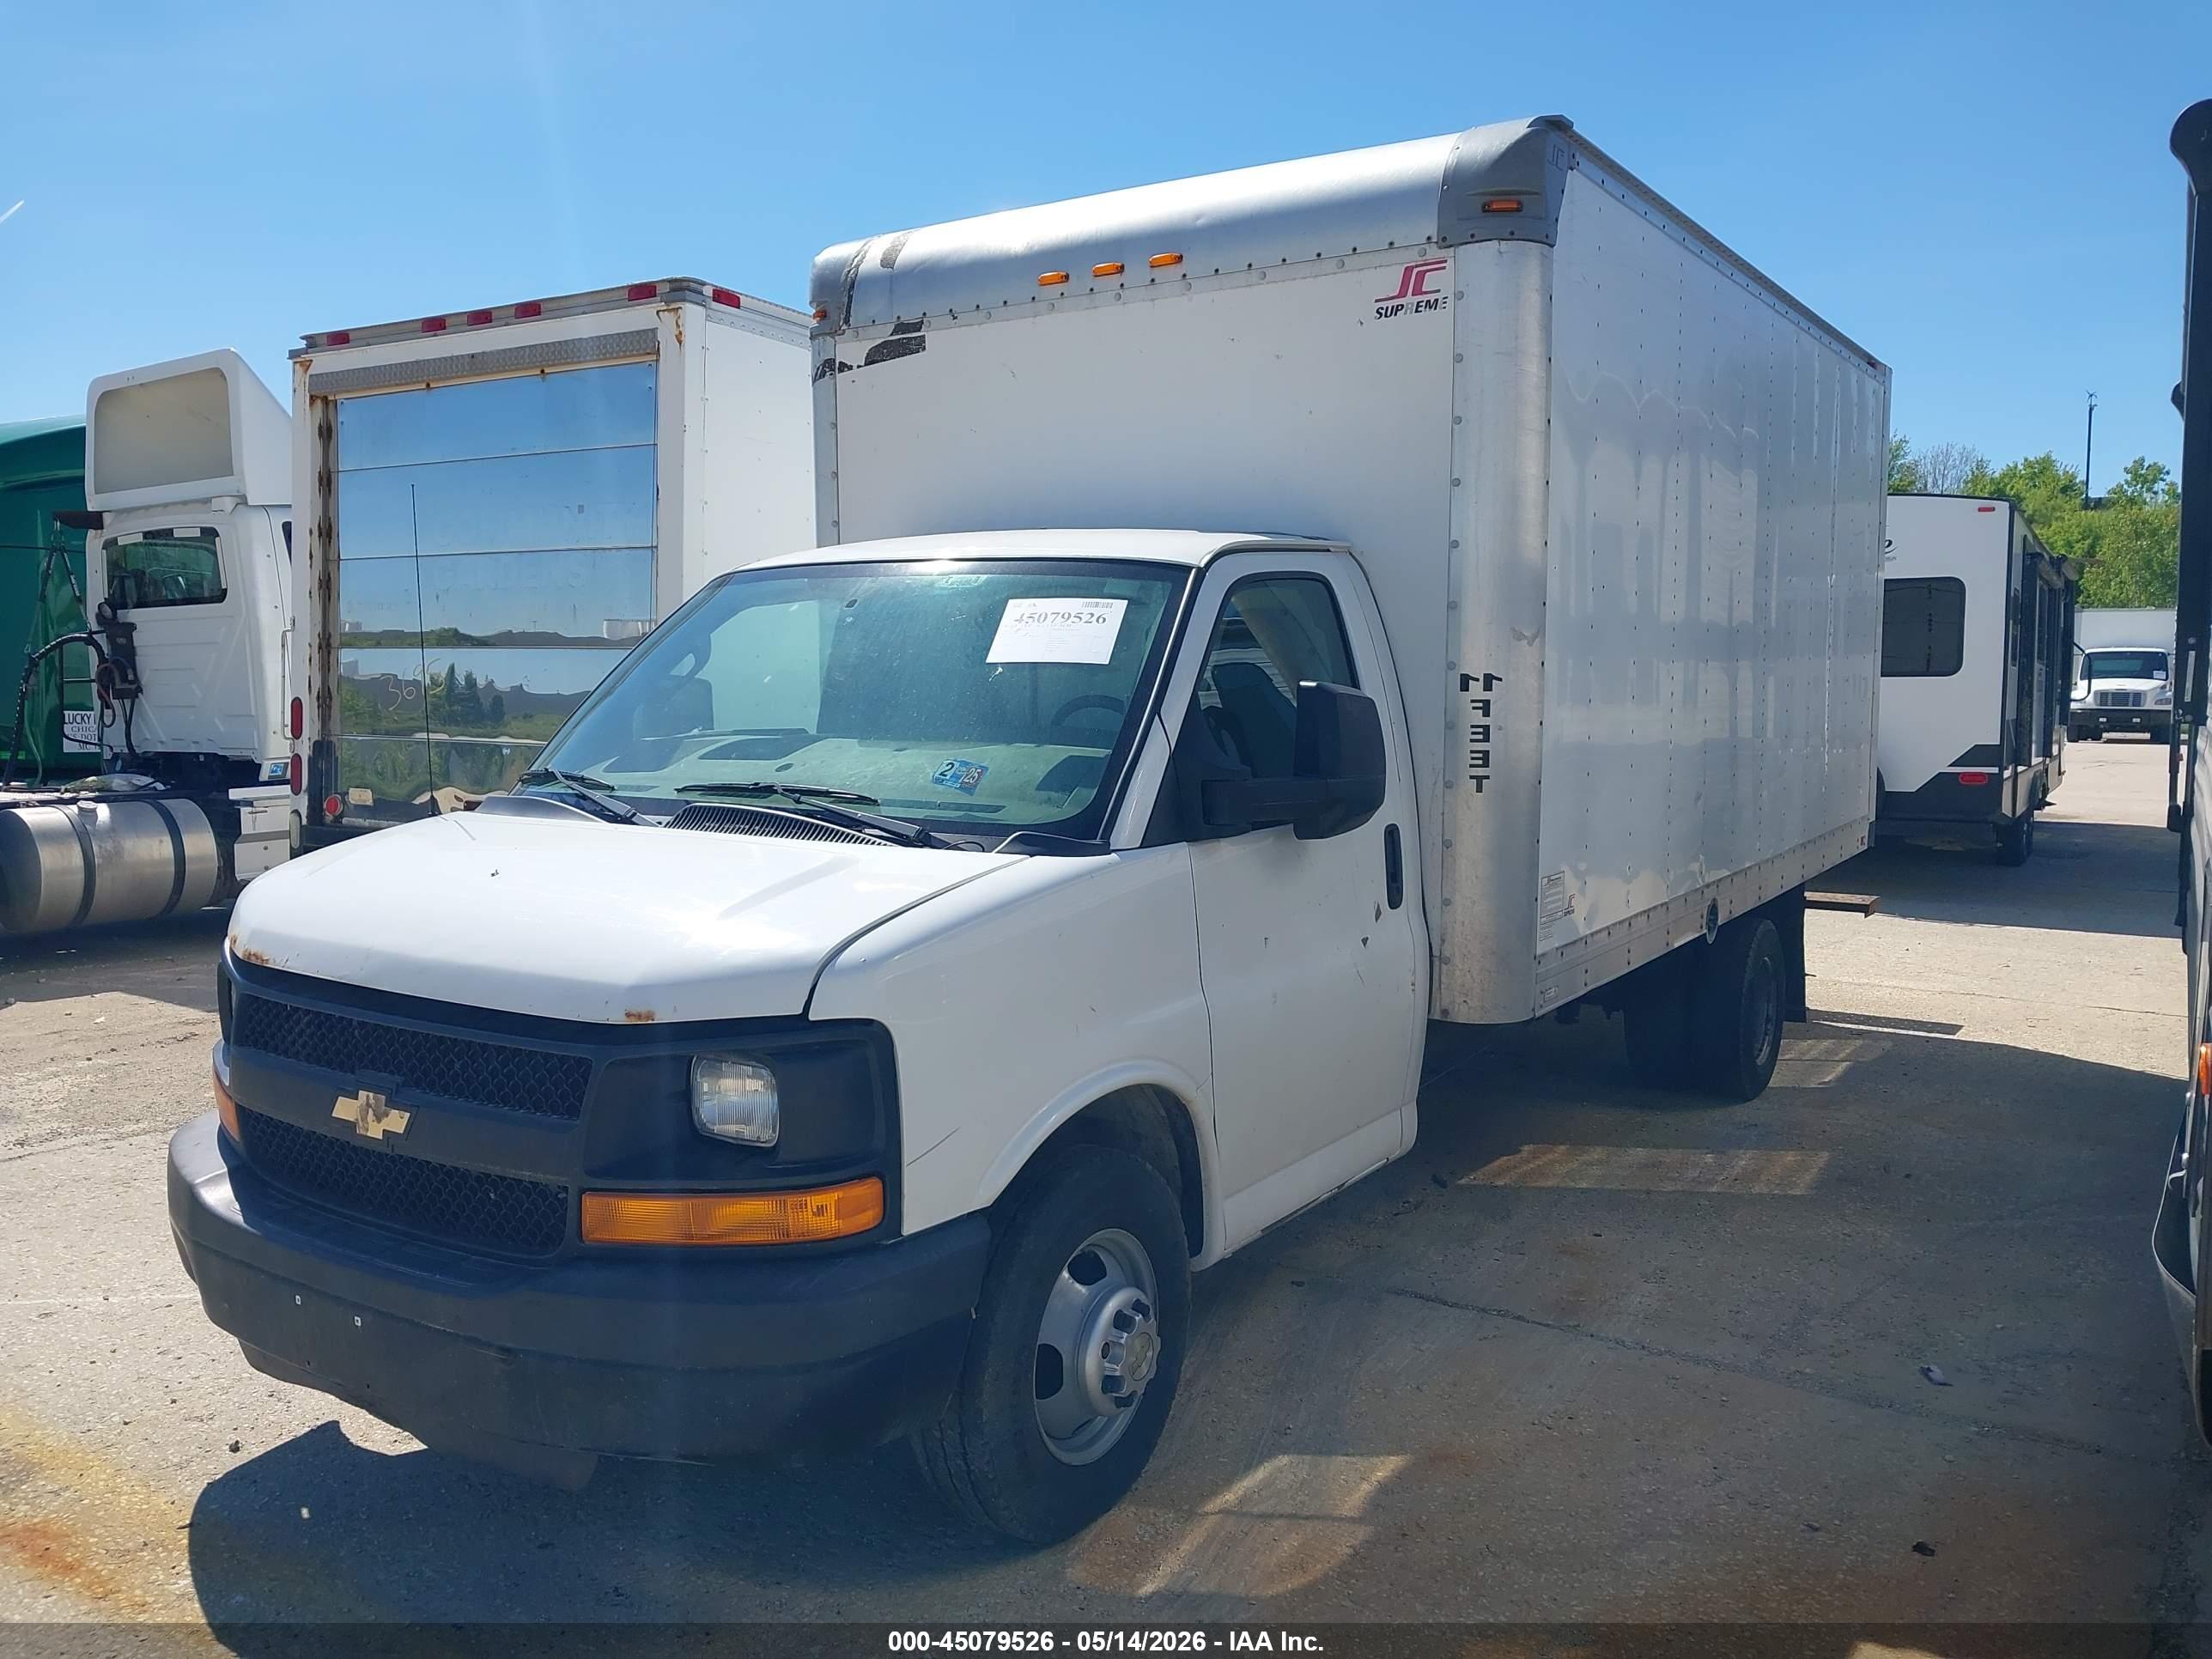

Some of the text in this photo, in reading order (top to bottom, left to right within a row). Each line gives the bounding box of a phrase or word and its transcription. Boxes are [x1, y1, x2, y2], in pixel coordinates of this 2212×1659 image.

[1374, 296, 1449, 320] SUPREME
[1013, 611, 1108, 625] 45079526
[939, 762, 955, 777] 2
